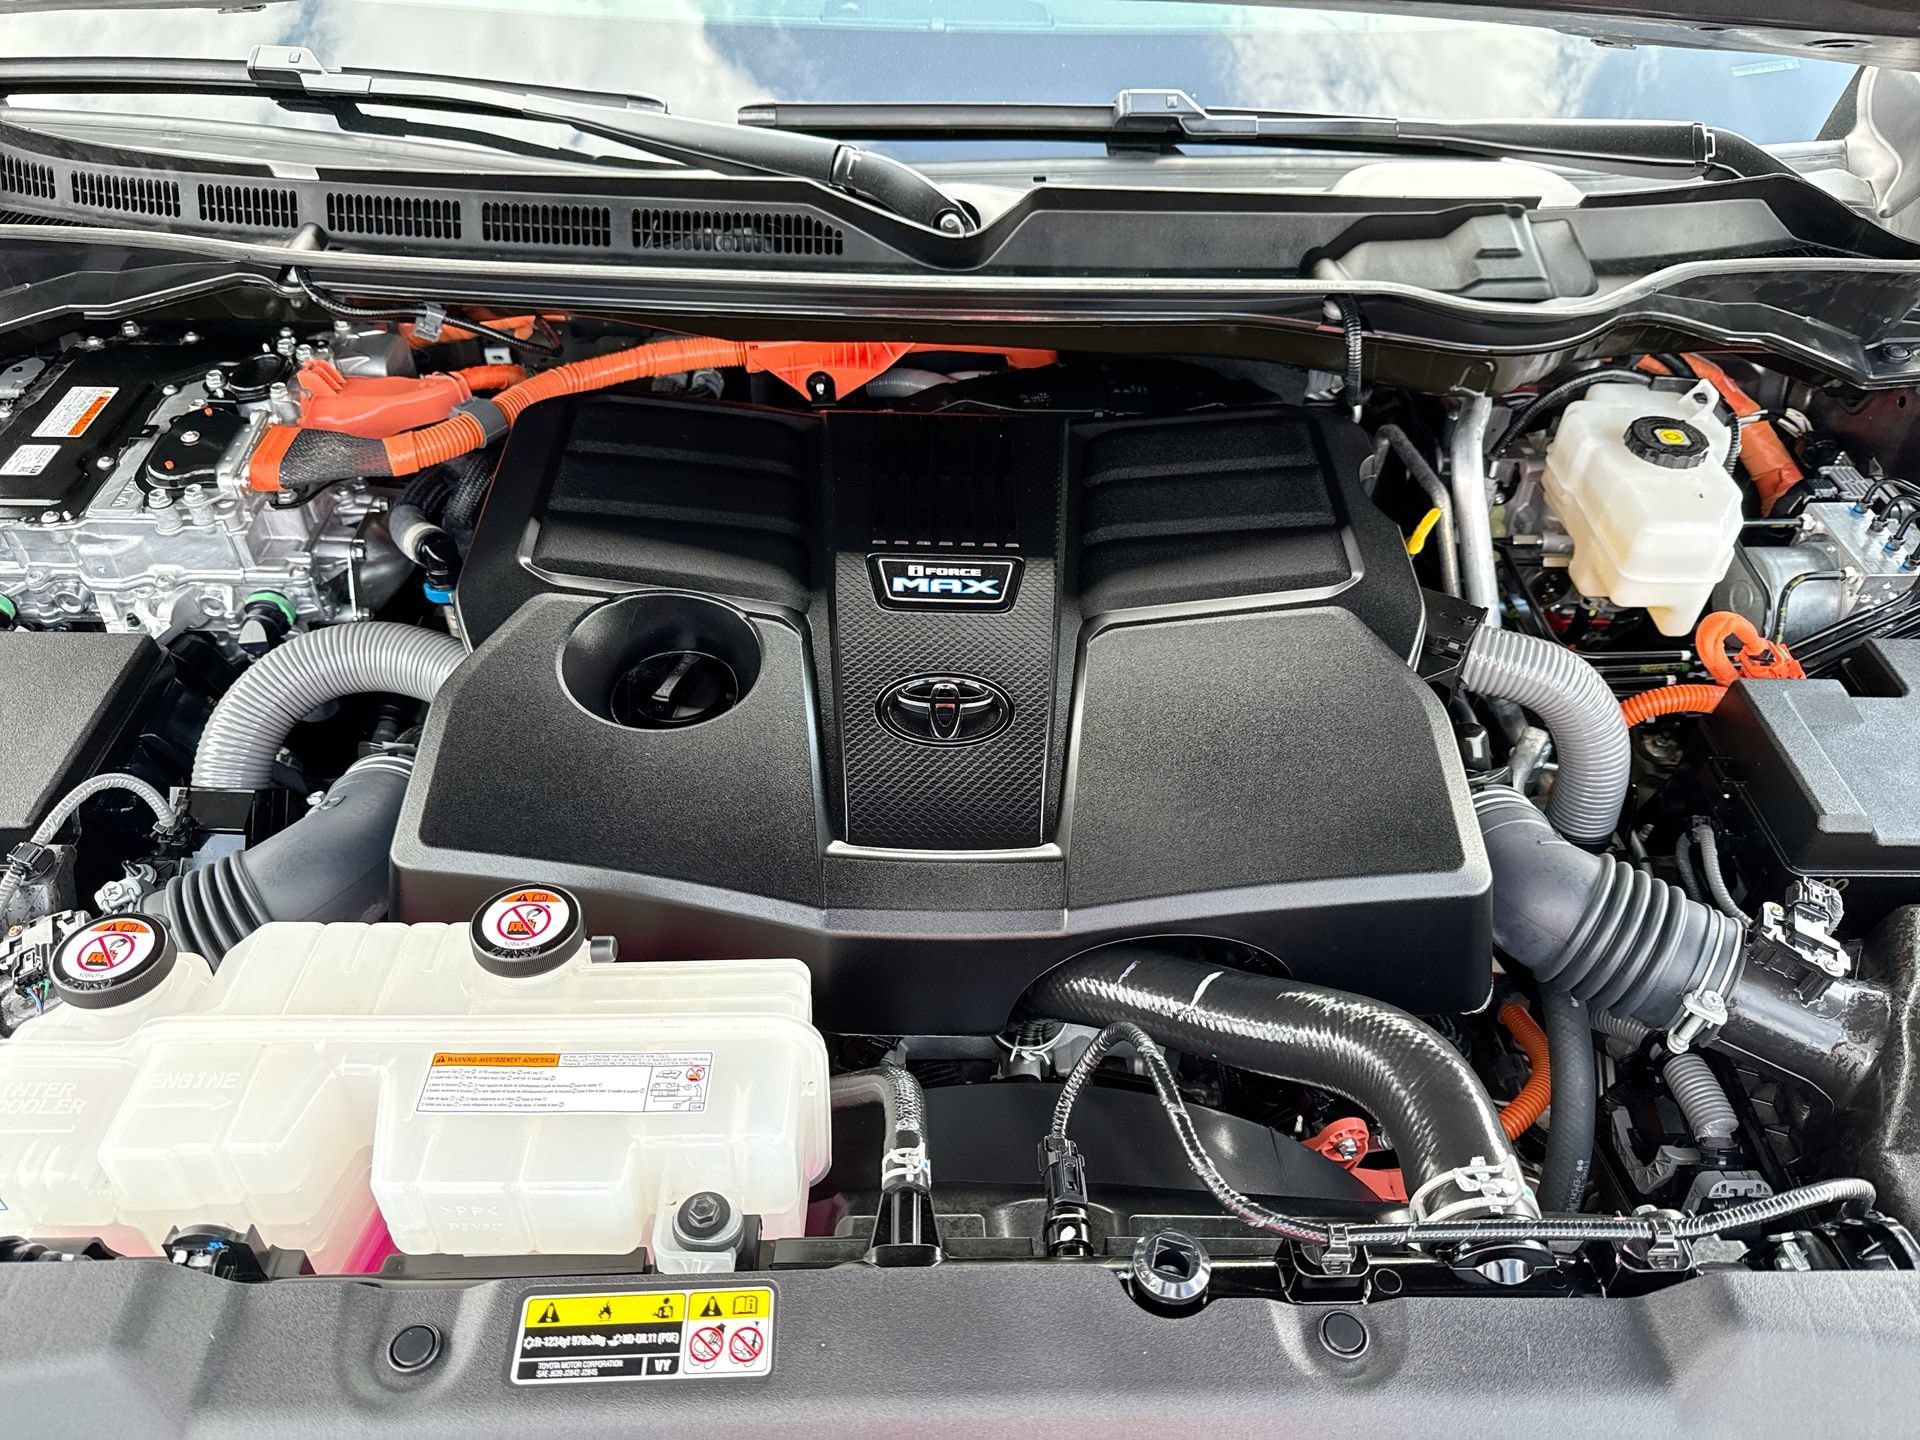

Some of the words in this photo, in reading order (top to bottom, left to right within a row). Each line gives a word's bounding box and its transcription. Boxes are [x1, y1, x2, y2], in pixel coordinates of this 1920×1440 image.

[892, 576, 1000, 595] MAX
[149, 1071, 241, 1089] ENGINE
[657, 1331, 680, 1345] (POE)
[537, 1361, 560, 1370] TOYOTA
[561, 1361, 582, 1369] MOTOR
[582, 1359, 624, 1369] CORPORATION
[654, 1359, 672, 1372] VY
